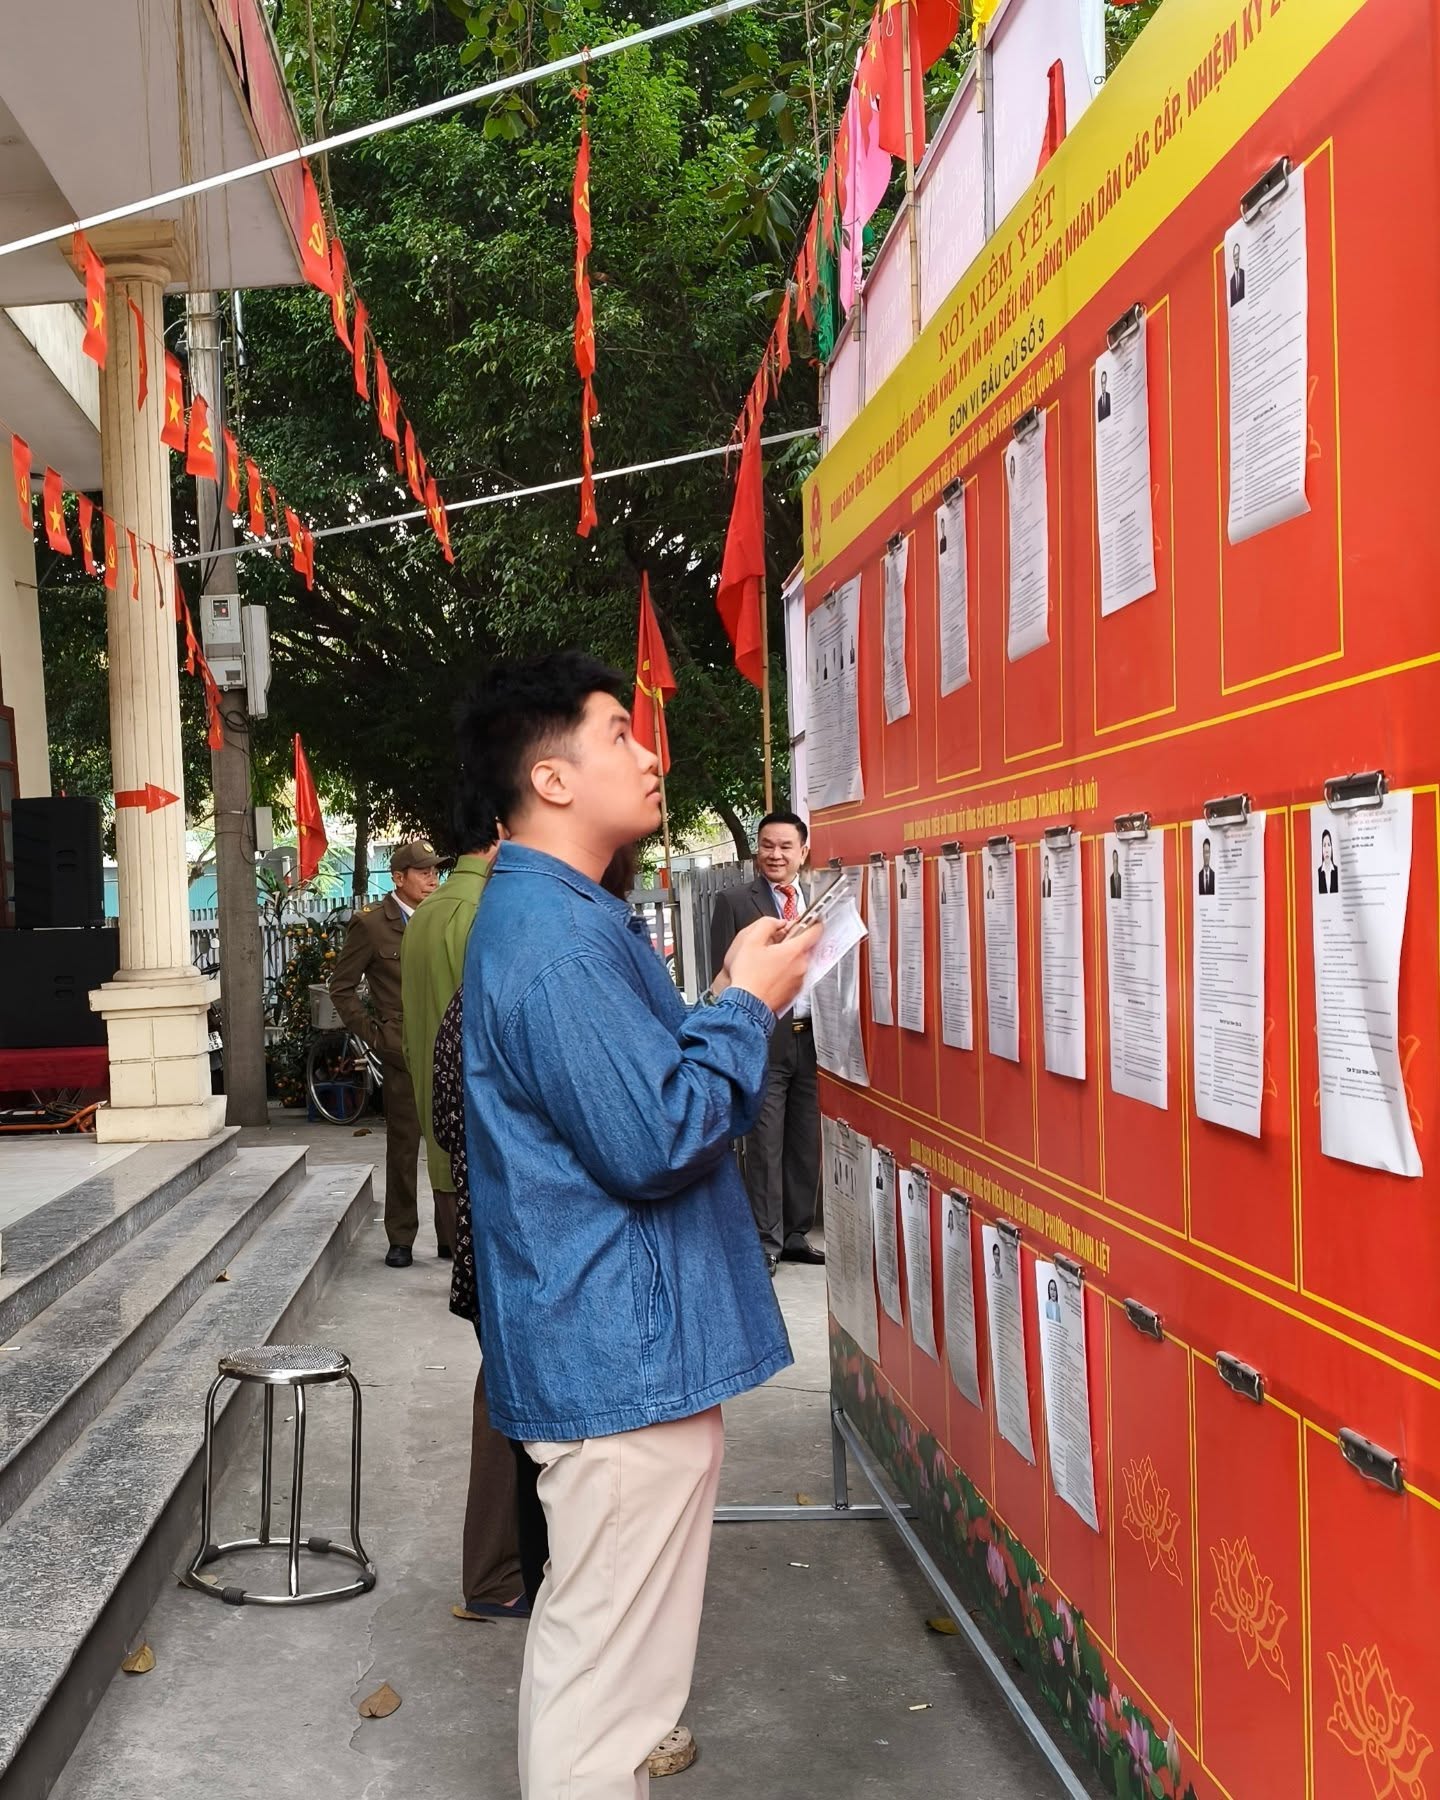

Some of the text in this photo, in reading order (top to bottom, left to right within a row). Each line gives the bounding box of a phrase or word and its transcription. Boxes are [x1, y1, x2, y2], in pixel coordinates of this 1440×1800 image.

[927, 383, 938, 419] HỘI
[959, 346, 970, 384] XVI
[972, 329, 982, 369] VÀ
[983, 316, 996, 356] ĐẠI
[999, 284, 1017, 339] BIỂU
[1020, 269, 1034, 315] HỘI
[1036, 237, 1062, 294] ĐỒNG
[1065, 197, 1094, 262] NHÂN
[1098, 163, 1122, 223] DÂN
[1125, 130, 1149, 189] CÁC
[1154, 87, 1183, 155] CẤP,
[1187, 20, 1238, 118] NHIỆM
[939, 303, 966, 362] NƠI
[969, 241, 1012, 325] NIÊM
[1017, 180, 1055, 262] YẾT
[949, 314, 1045, 437] ĐƠN VỊ BẦU CỬ SỐ 3
[1036, 351, 1054, 399] QUỐC
[1054, 342, 1066, 380] HỘI
[1074, 779, 1085, 812] HÀ
[1085, 776, 1098, 815] NỘI
[1045, 1211, 1072, 1251] PHƯỜNG
[1072, 1226, 1095, 1265] THANH
[1095, 1237, 1110, 1278] LIỆT
